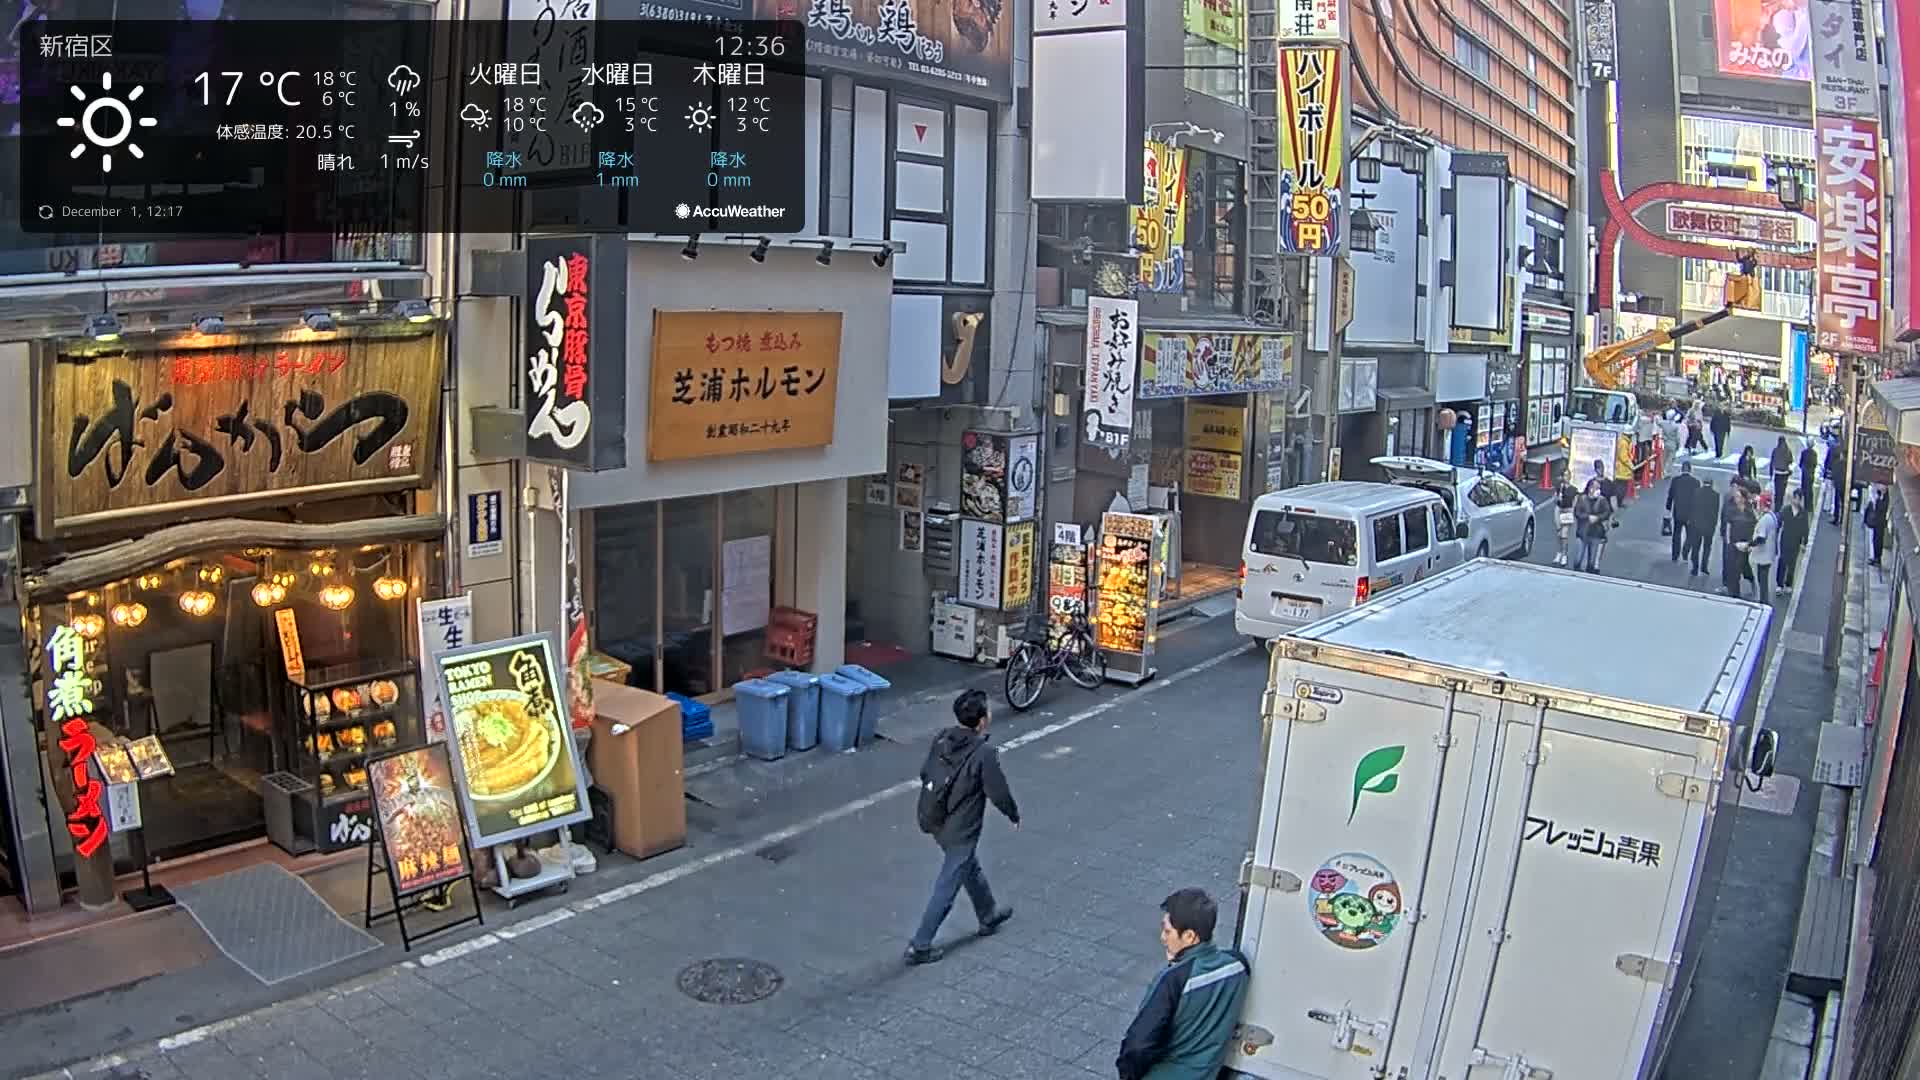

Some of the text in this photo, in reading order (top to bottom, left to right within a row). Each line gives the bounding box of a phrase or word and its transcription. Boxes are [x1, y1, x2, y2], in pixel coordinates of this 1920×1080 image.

[1591, 62, 1612, 78] 7F
[1821, 83, 1870, 95] RESTAURANT
[1834, 95, 1857, 110] 3F
[1297, 51, 1324, 190] ハイボール
[1164, 147, 1178, 288] ハイボール
[1821, 124, 1878, 328] 安楽亭
[563, 251, 590, 400] 東京豚骨
[1821, 331, 1839, 346] 2F
[1104, 308, 1132, 414] お好み焼き
[672, 365, 827, 405] 芝浦ホルモン
[1105, 431, 1129, 446] B1F
[444, 660, 492, 681] TOKYO
[447, 674, 493, 694] RAMEN
[1523, 814, 1662, 868] フレッシュ青果
